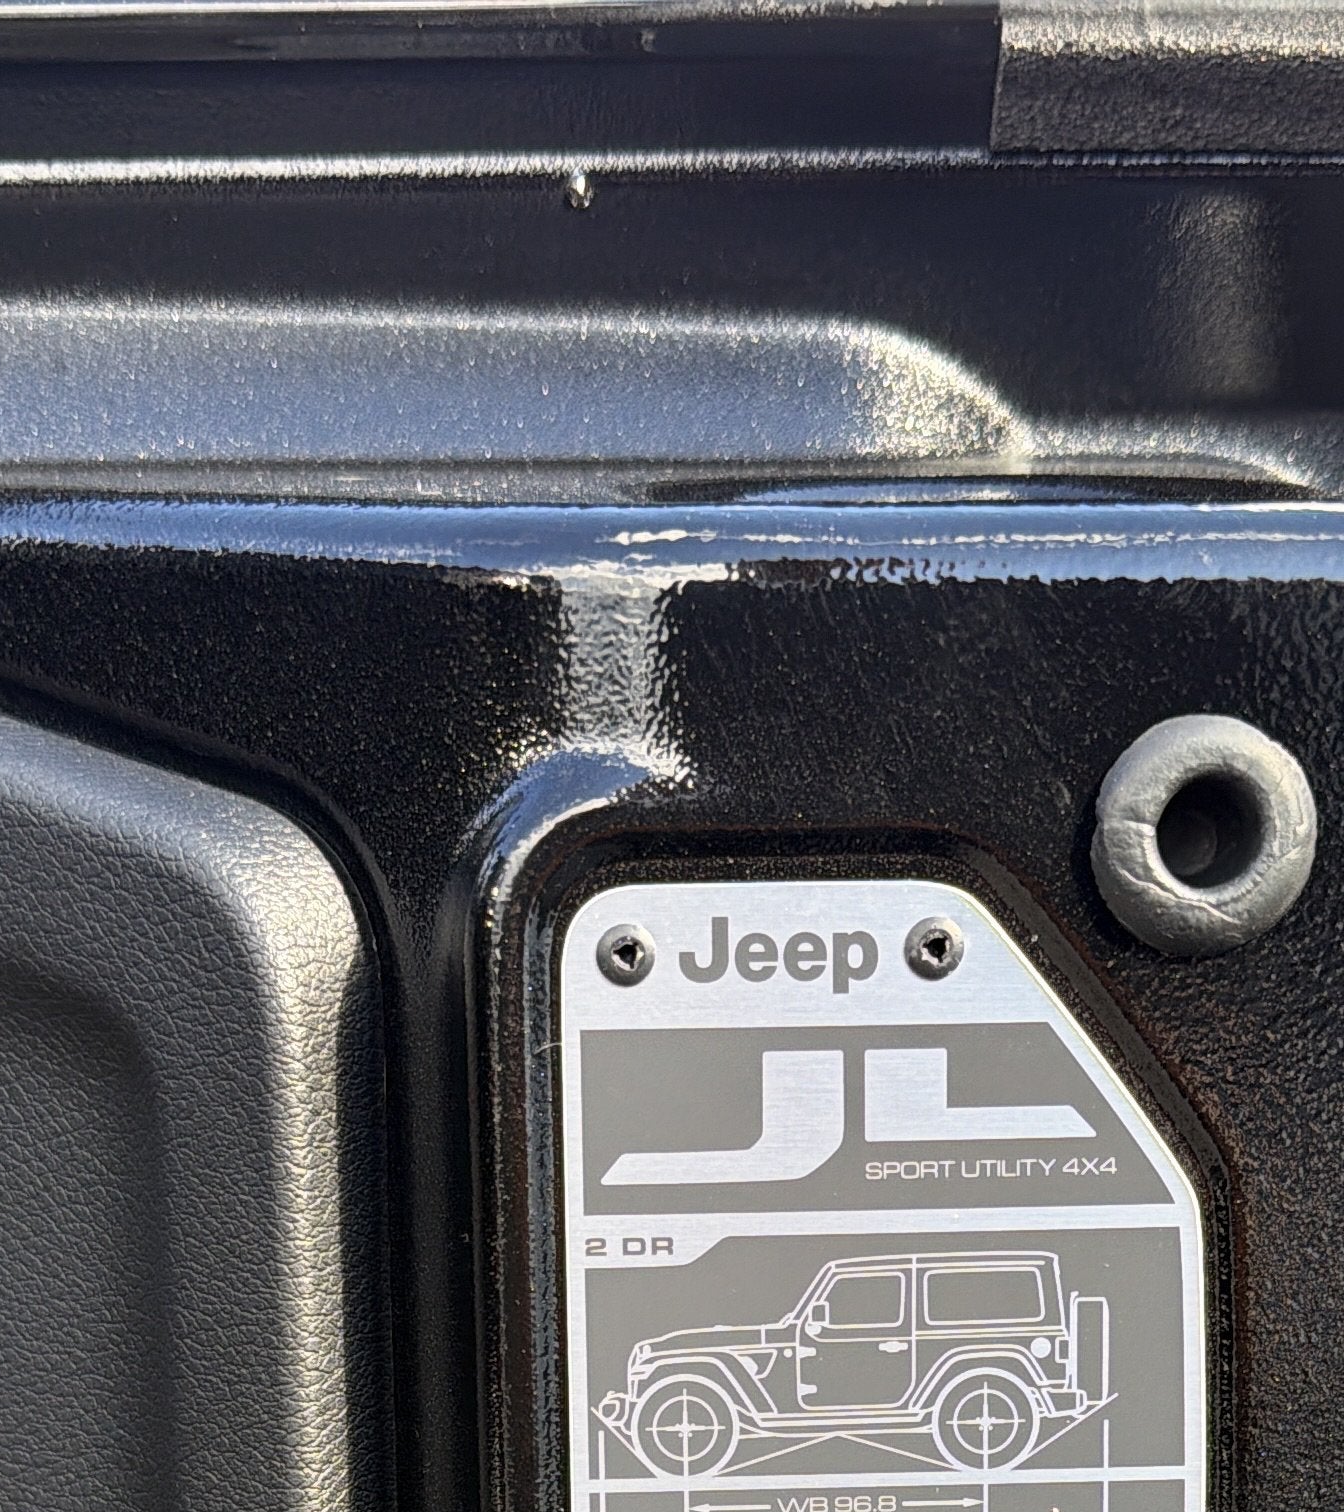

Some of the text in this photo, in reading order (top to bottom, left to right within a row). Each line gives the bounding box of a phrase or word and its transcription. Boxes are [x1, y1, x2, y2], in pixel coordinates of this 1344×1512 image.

[678, 916, 879, 995] Jeep
[600, 1047, 1098, 1186] JL
[865, 1156, 1118, 1180] SPORT UTILITY 4X4
[584, 1236, 674, 1257] 2 DR
